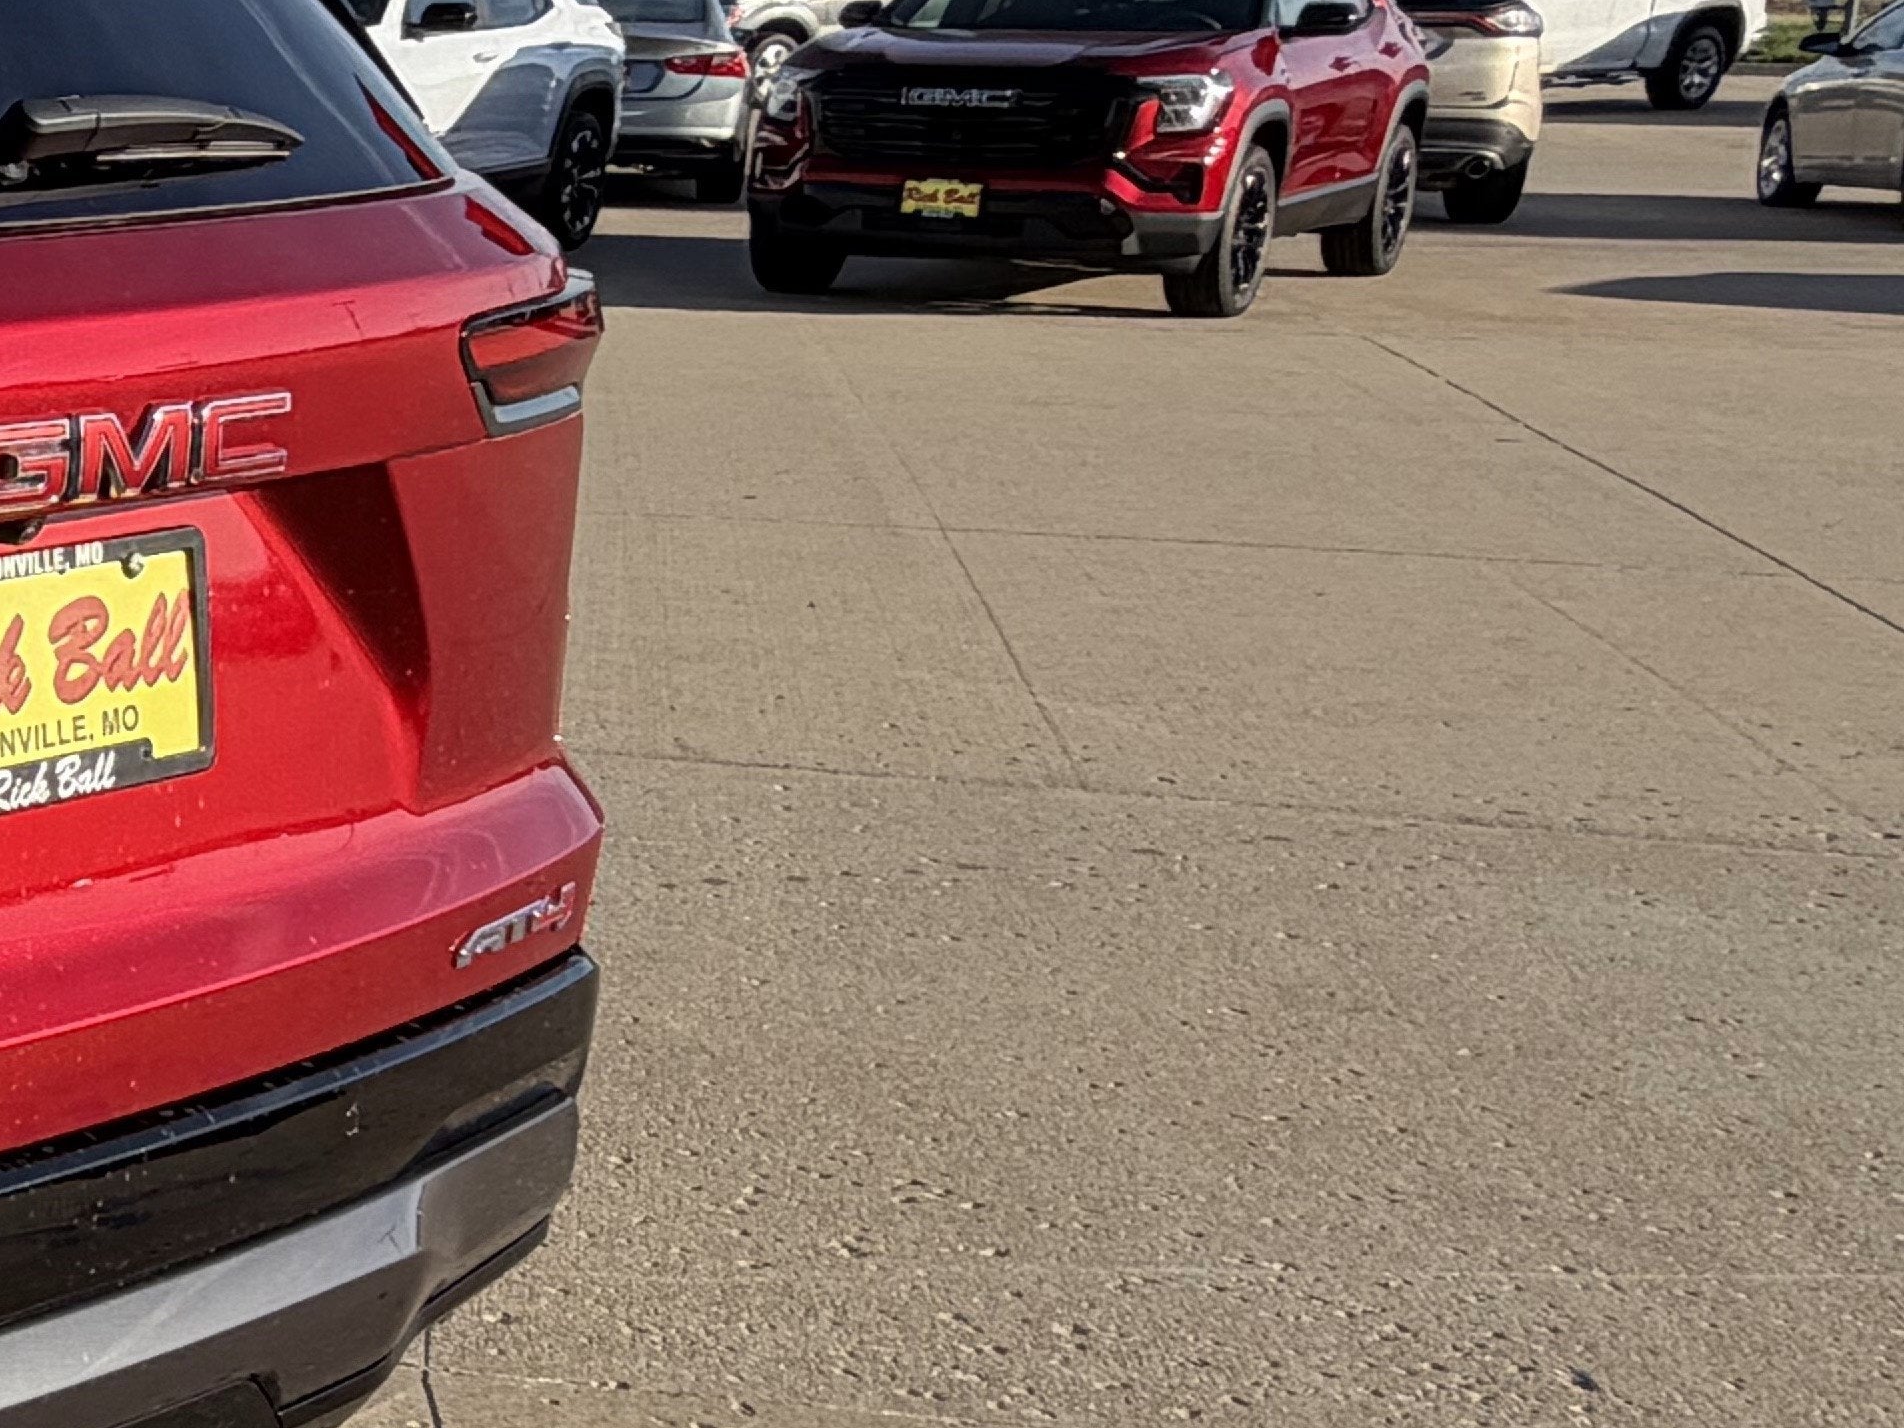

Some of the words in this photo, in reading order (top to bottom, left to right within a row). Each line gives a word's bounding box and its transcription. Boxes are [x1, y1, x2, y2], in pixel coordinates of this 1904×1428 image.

[75, 541, 104, 567] MO
[48, 588, 189, 704] Ball
[102, 705, 140, 736] MO
[54, 752, 117, 800] Ball
